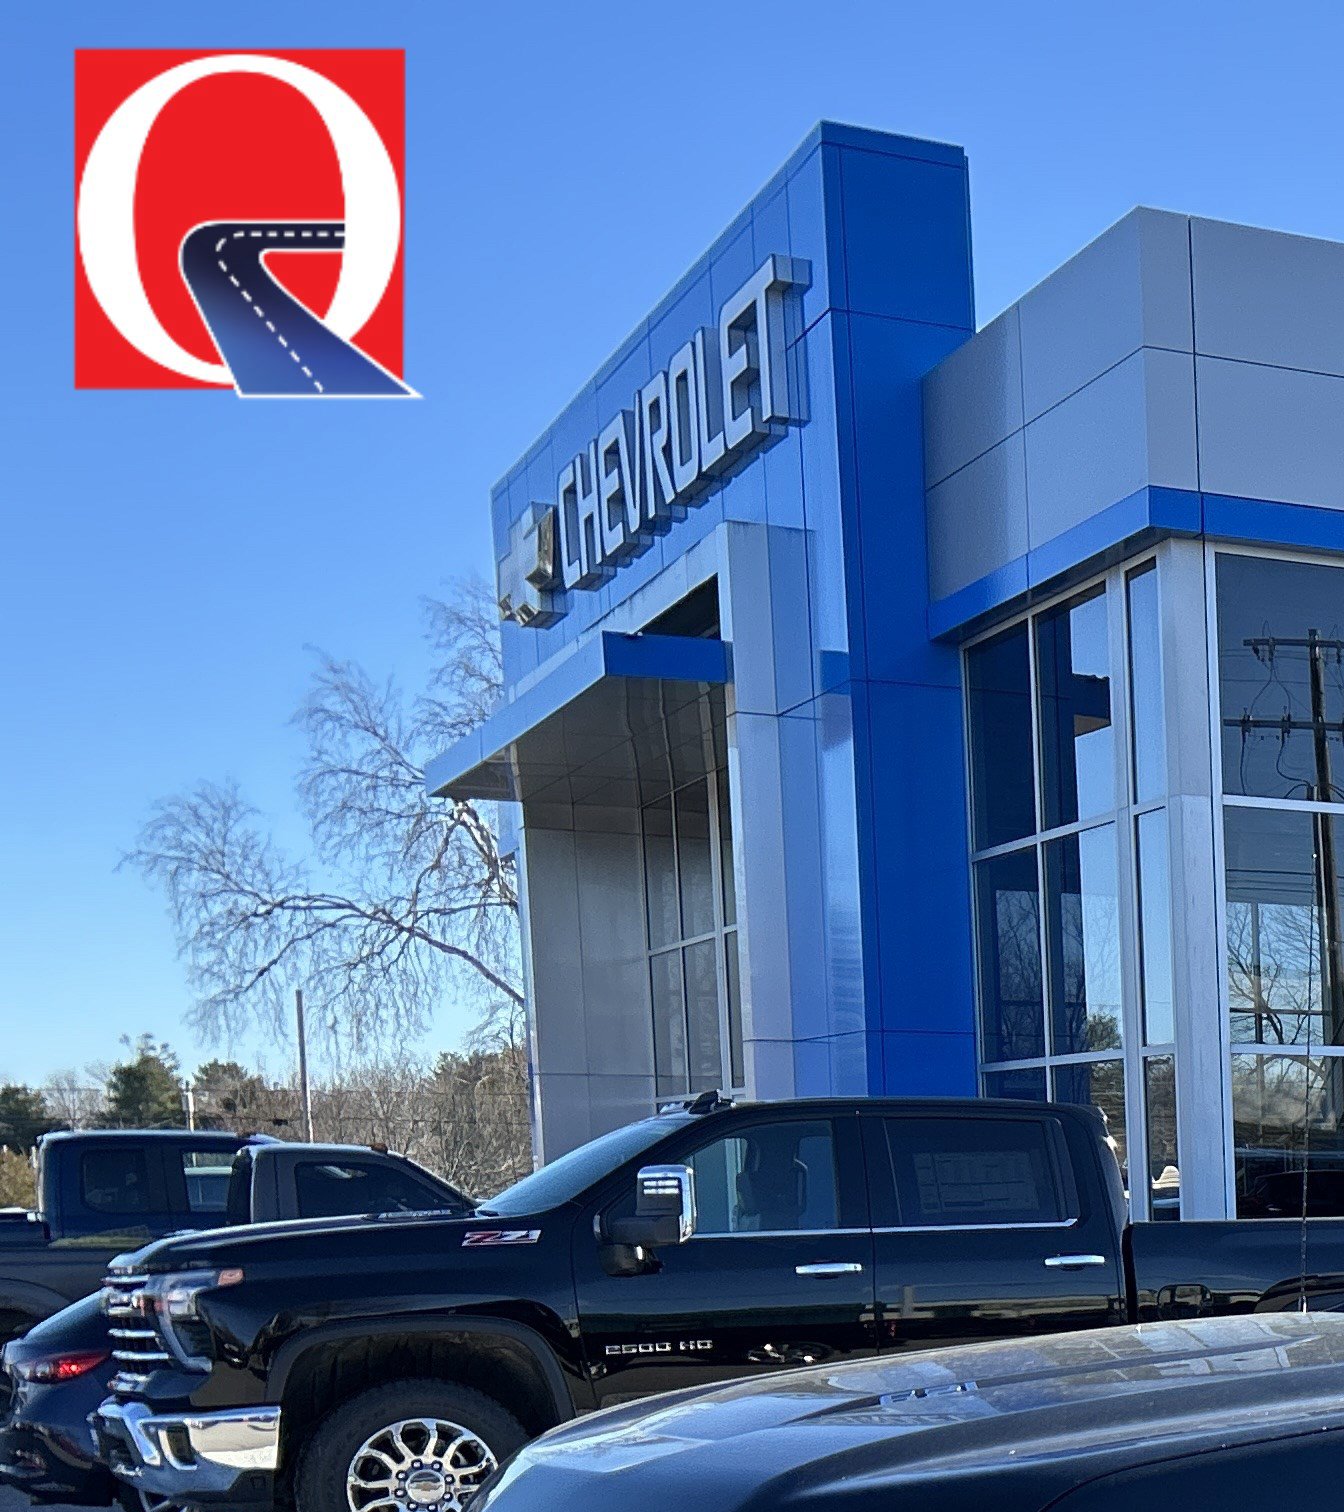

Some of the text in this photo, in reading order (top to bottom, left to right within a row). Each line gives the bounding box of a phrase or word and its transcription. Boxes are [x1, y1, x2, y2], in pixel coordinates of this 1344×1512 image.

[557, 253, 780, 591] CHEVROLET
[461, 1229, 542, 1247] Z71
[605, 1339, 713, 1355] 2500 HD
